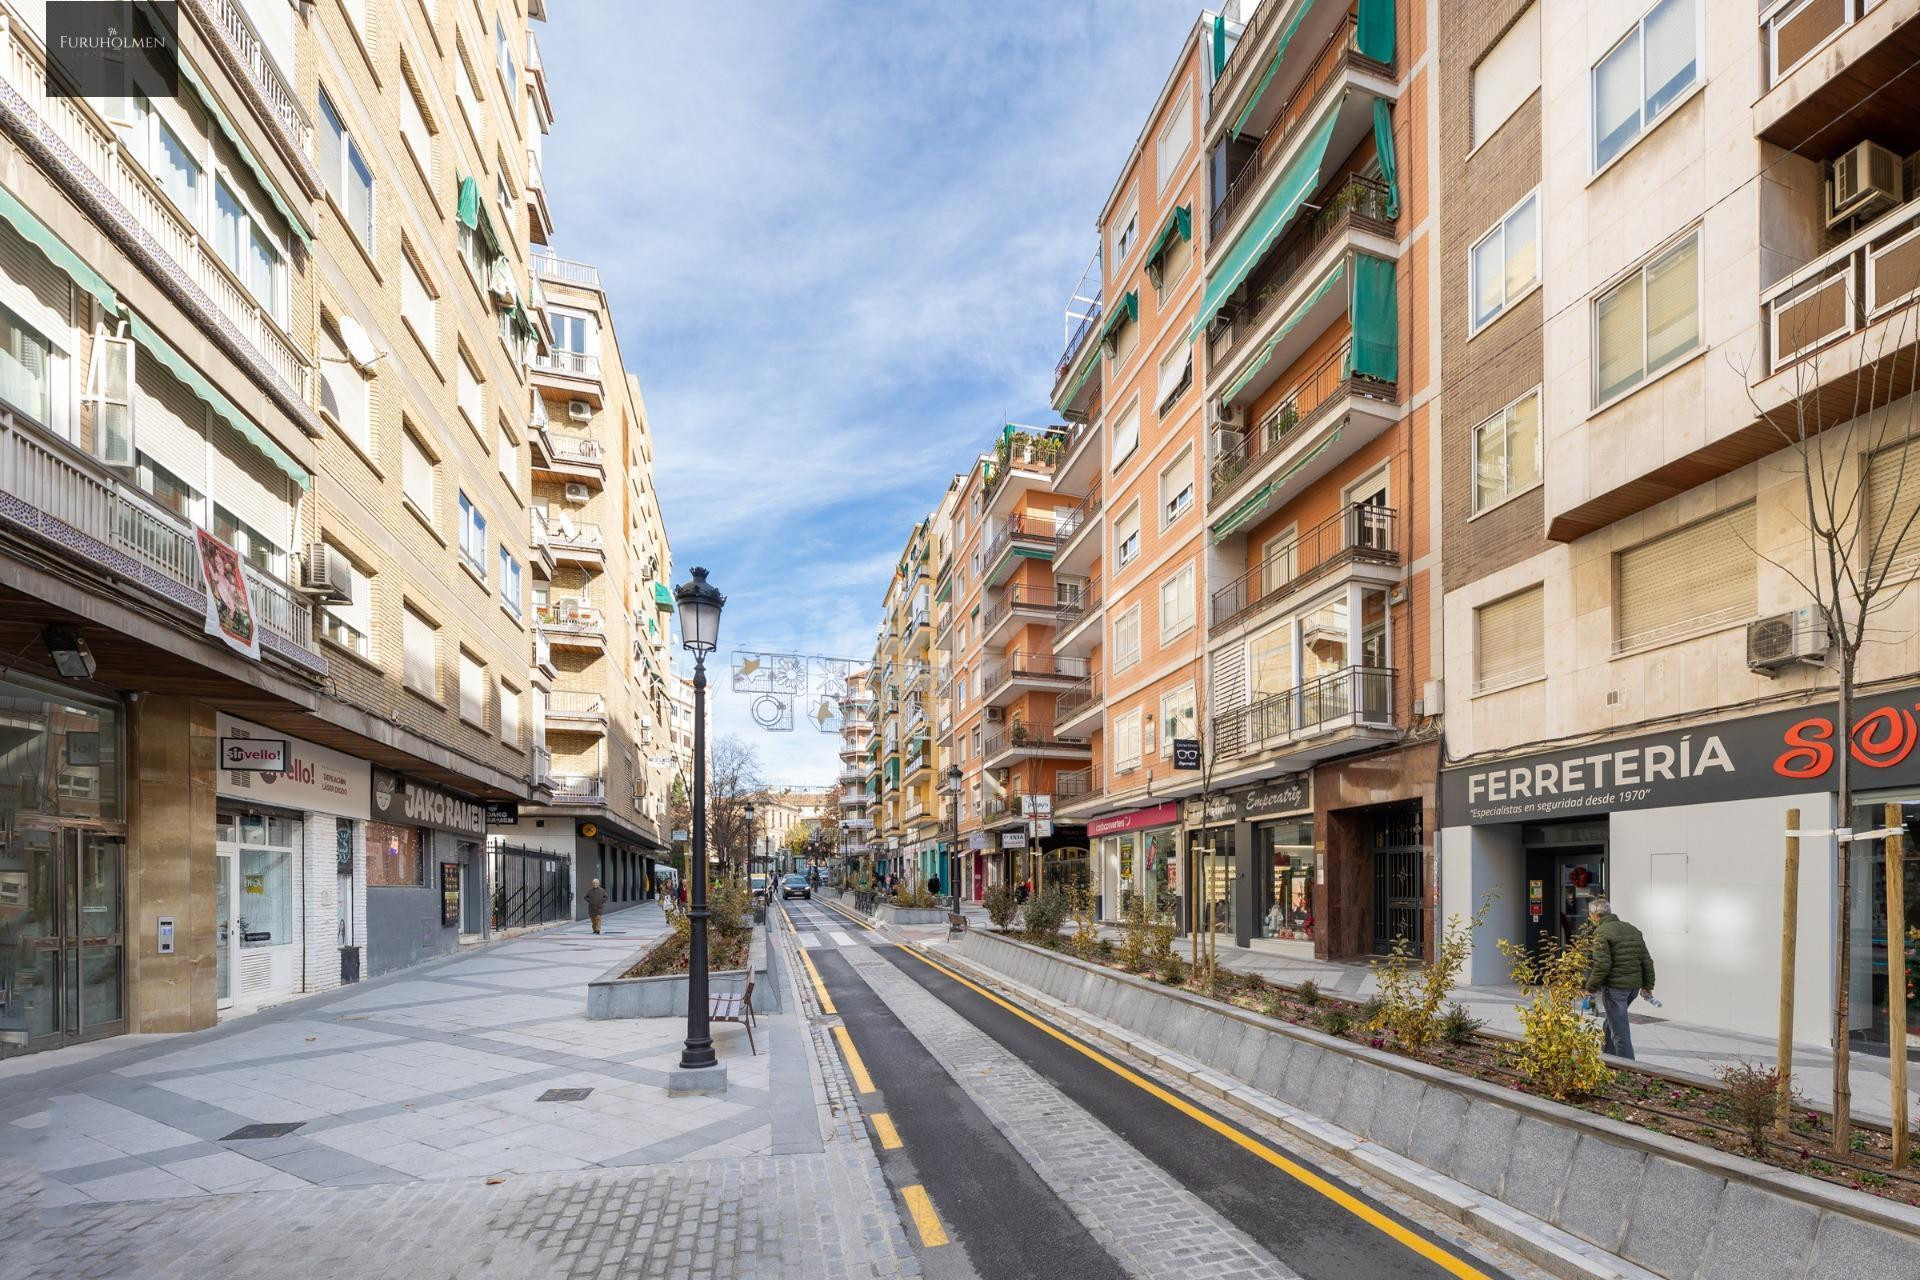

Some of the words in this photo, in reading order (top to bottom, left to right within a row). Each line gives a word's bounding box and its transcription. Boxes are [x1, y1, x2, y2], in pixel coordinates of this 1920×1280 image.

[1468, 735, 1736, 804] FERRETERÍA
[1772, 703, 1920, 779] SO
[405, 784, 444, 824] JAKO
[446, 796, 486, 835] RAMEN
[1524, 803, 1535, 812] en
[1537, 796, 1584, 813] seguridad
[1585, 793, 1616, 806] desde
